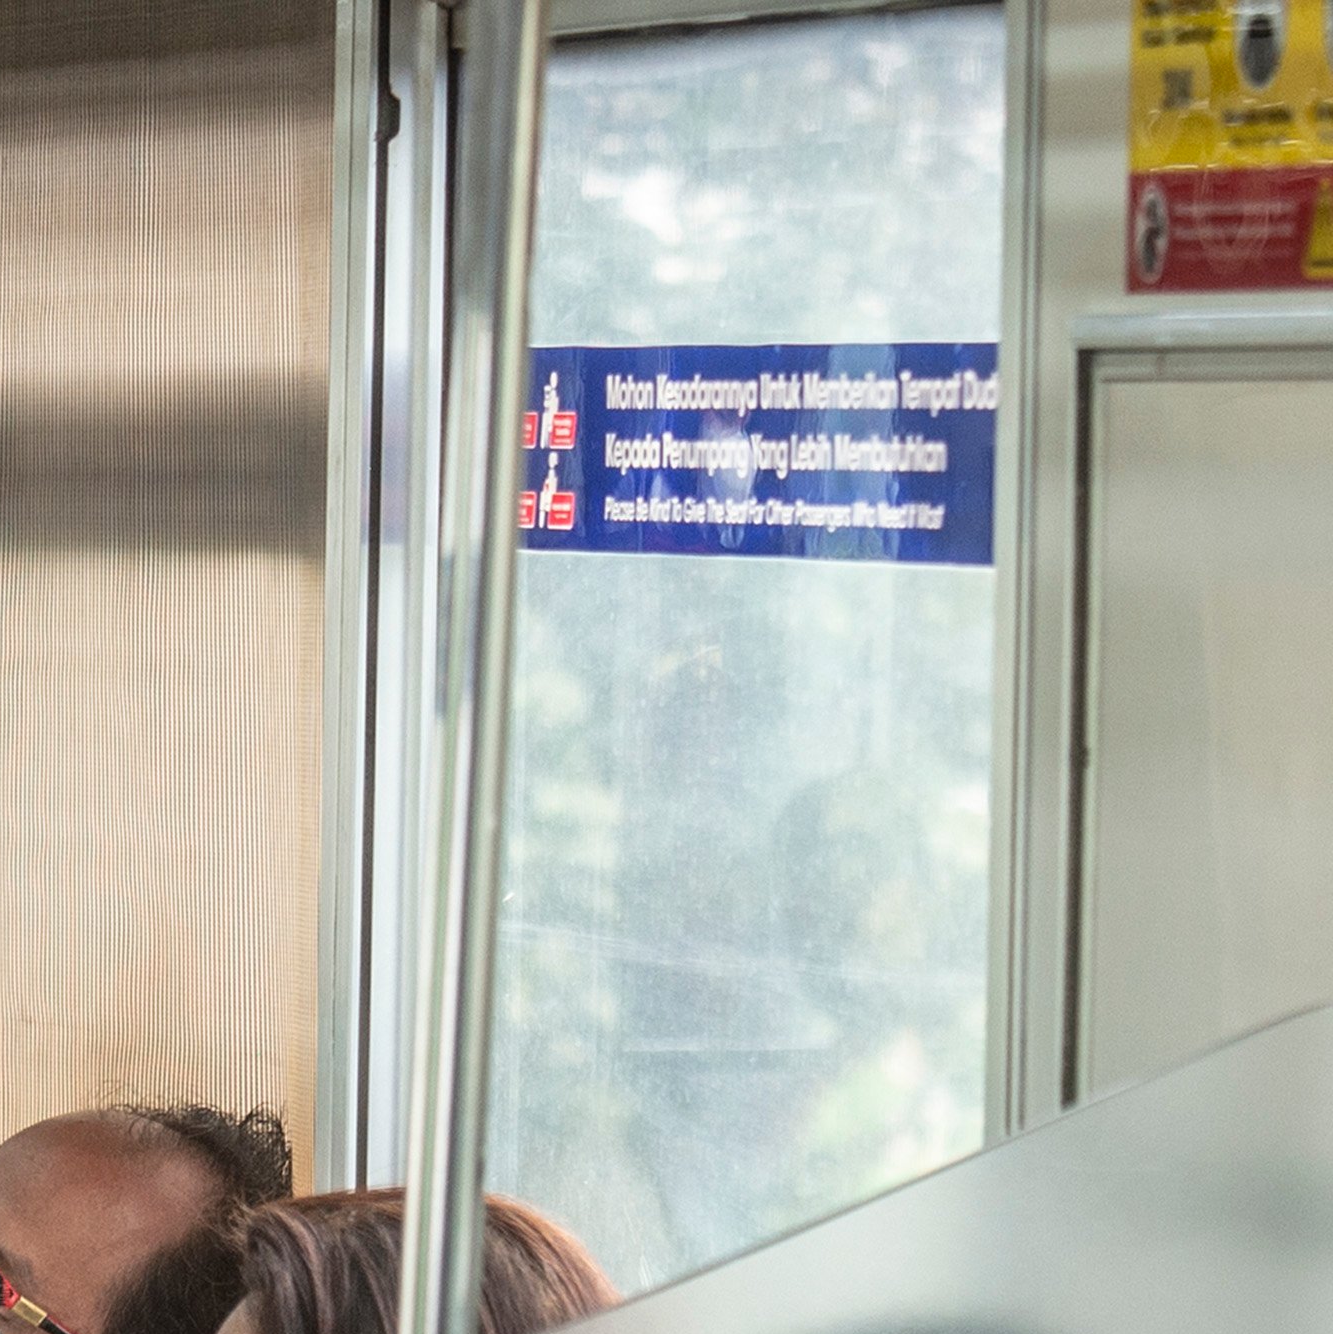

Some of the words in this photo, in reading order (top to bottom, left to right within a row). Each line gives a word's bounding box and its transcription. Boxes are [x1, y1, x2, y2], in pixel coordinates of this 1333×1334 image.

[606, 373, 654, 411] Mohon
[656, 373, 757, 418] Kesadarannya
[760, 373, 802, 411] Untuk
[803, 372, 898, 410] Memberikan
[900, 371, 961, 418] Tempat
[605, 433, 660, 476] Kepada
[662, 431, 751, 480] Penumpang
[751, 433, 788, 480] Yang
[790, 434, 831, 470] Lebih
[834, 434, 947, 472] Membutuhkan
[604, 496, 635, 522] Please
[684, 497, 706, 523] Give
